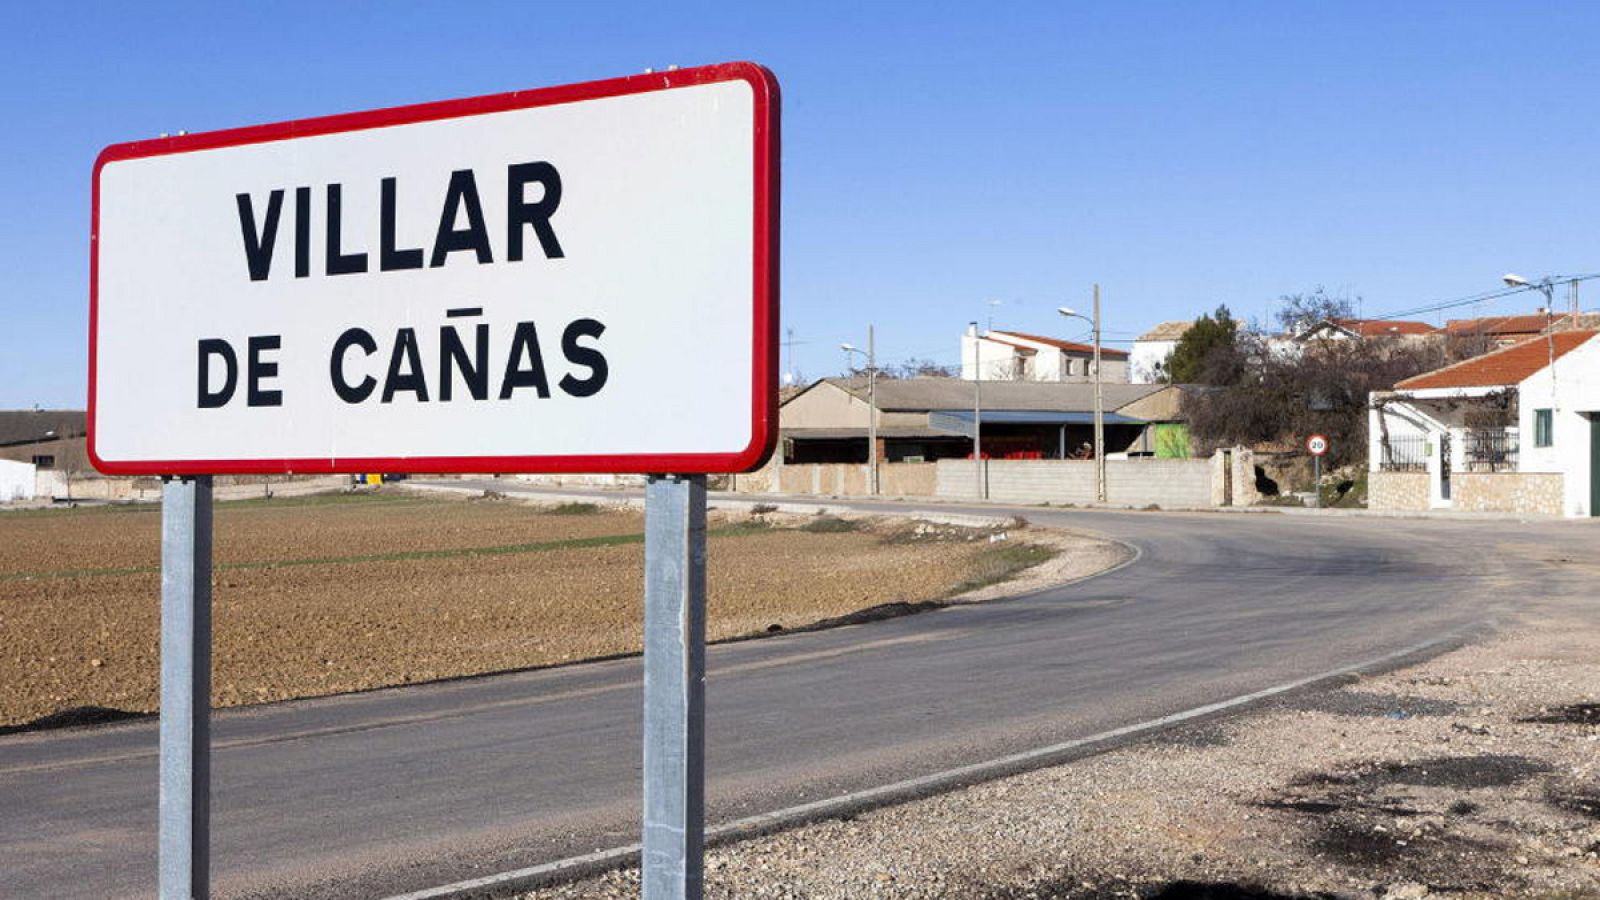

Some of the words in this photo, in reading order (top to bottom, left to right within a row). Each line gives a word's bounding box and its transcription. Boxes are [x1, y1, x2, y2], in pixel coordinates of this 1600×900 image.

[235, 161, 565, 282] VILLAR
[197, 335, 283, 409] DE
[330, 307, 609, 404] CAÑAS
[1311, 440, 1324, 449] 20
